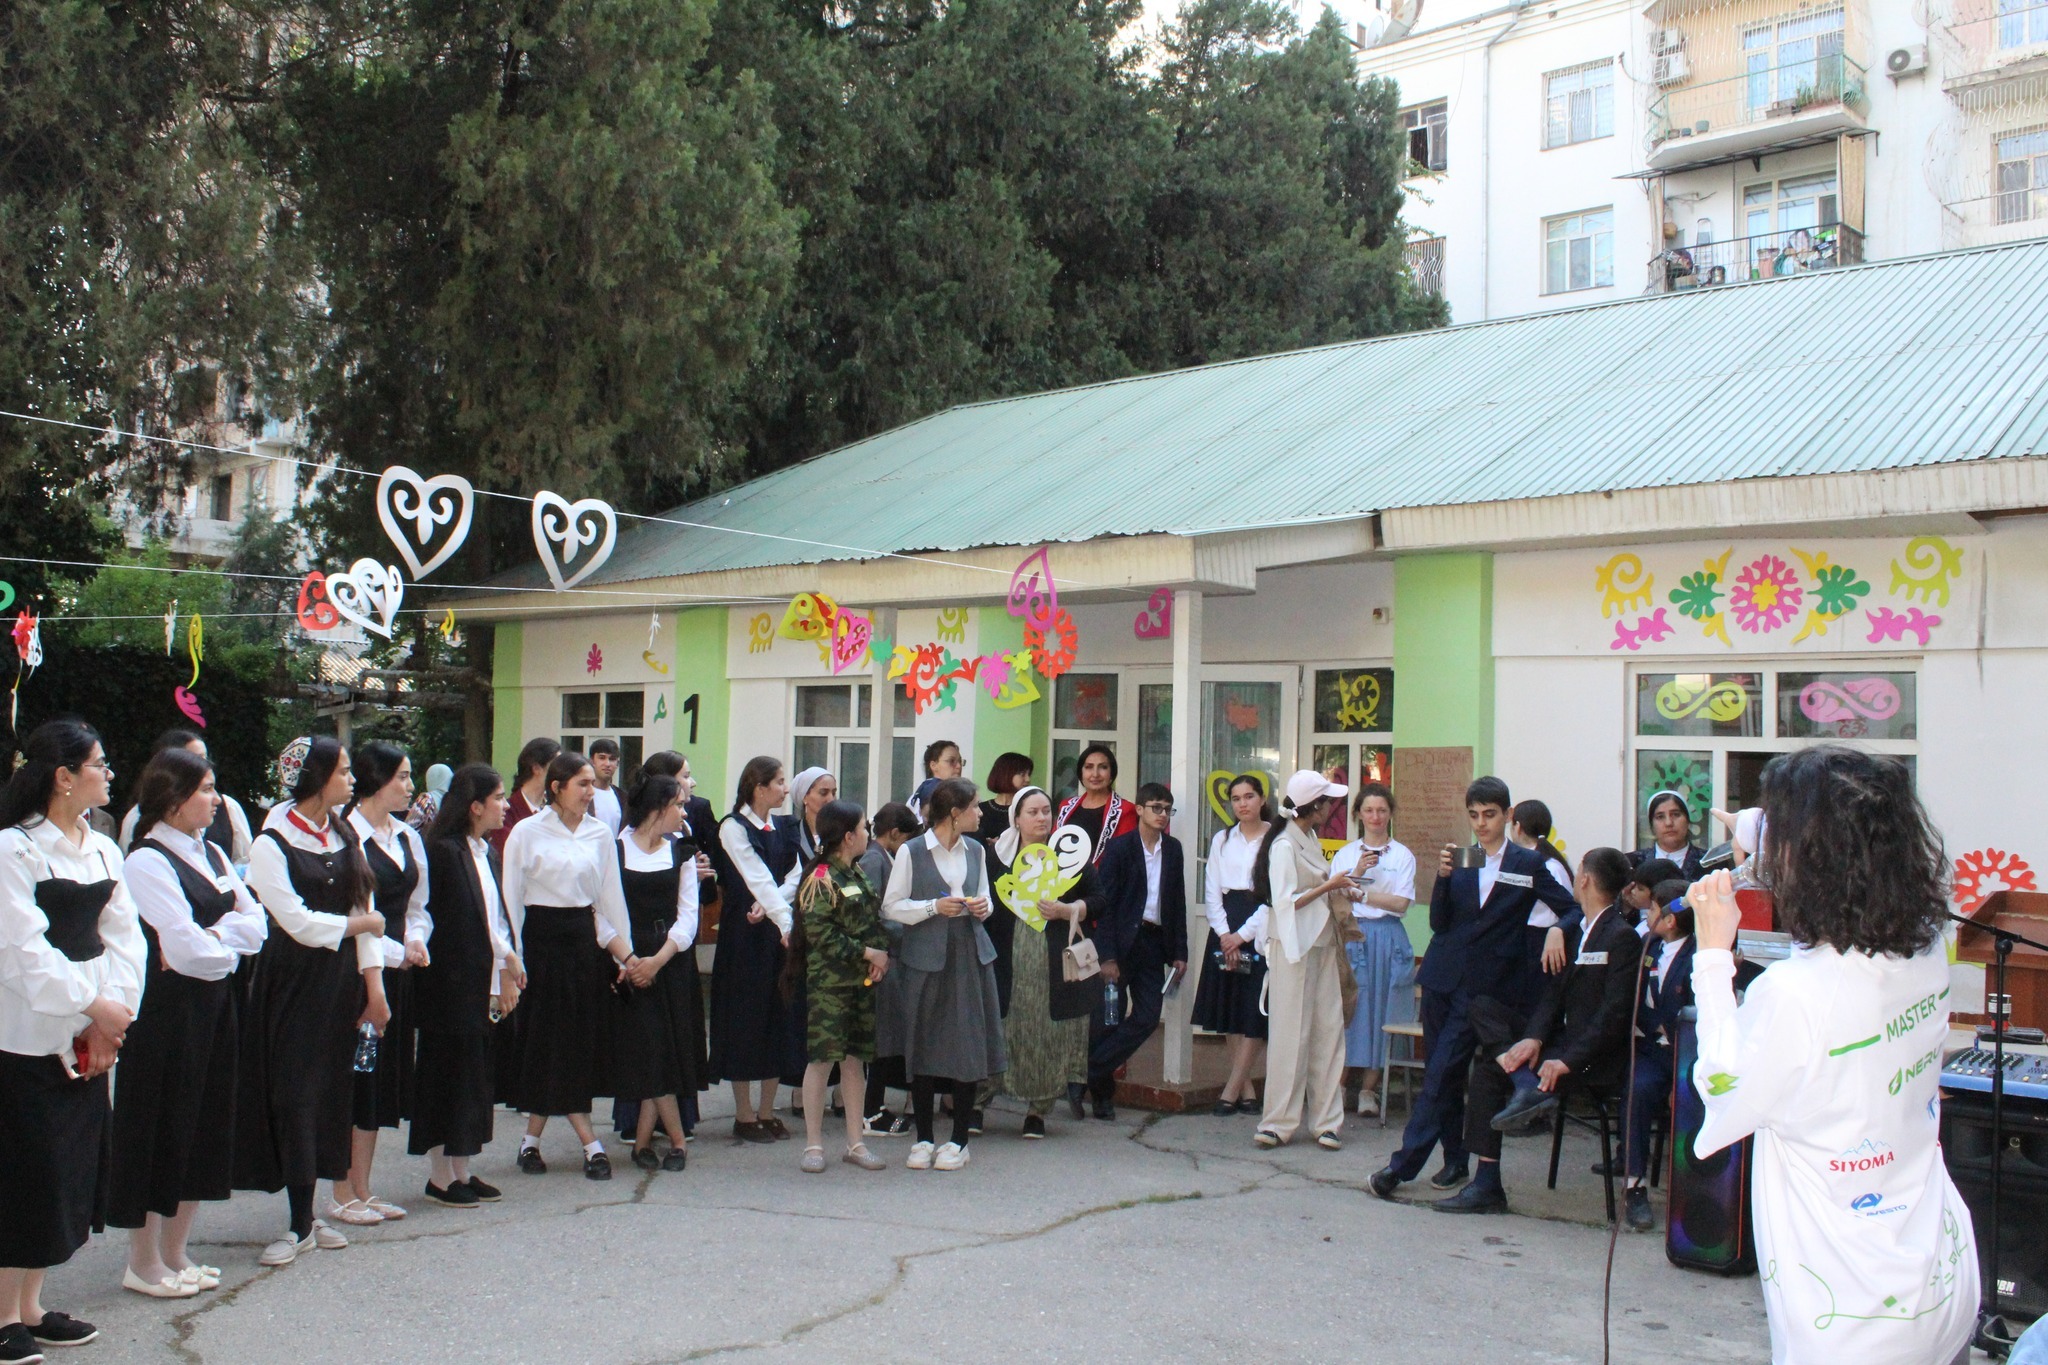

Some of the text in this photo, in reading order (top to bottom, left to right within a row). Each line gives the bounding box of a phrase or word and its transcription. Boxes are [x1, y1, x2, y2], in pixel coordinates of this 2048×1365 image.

[683, 693, 700, 745] 1
[1886, 993, 1937, 1043] MASTER
[1829, 1151, 1895, 1172] SIYOMA
